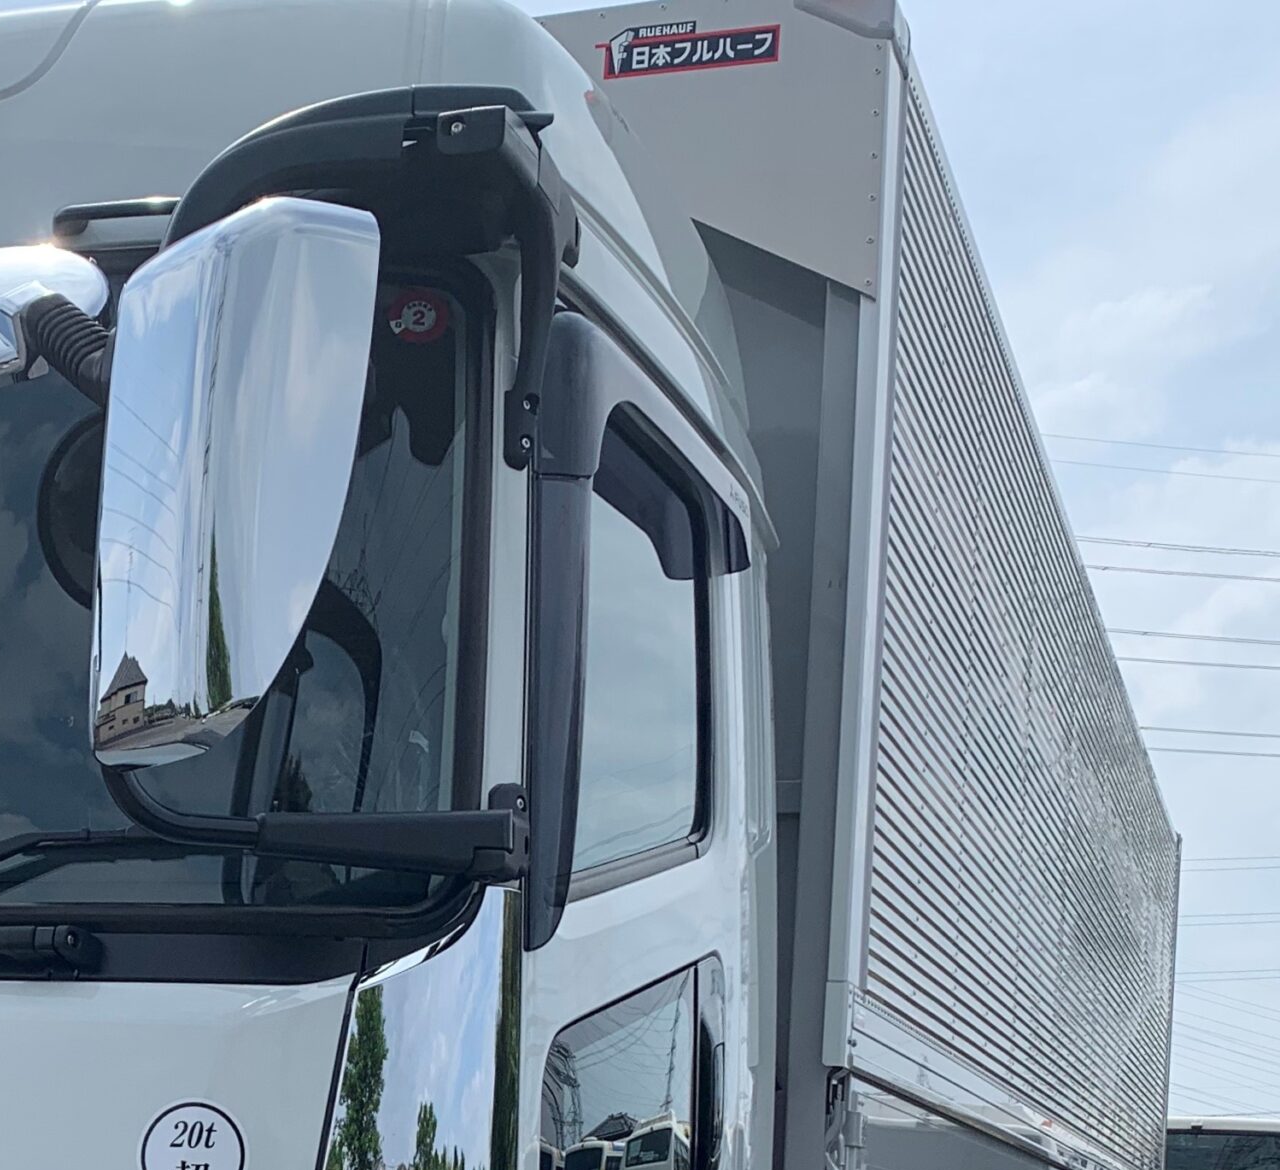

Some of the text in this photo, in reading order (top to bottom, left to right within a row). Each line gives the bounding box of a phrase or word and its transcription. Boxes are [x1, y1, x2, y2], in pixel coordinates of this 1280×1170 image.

[631, 33, 773, 70] 日本フルハーフ
[412, 310, 426, 326] 2
[169, 1120, 218, 1149] 20t
